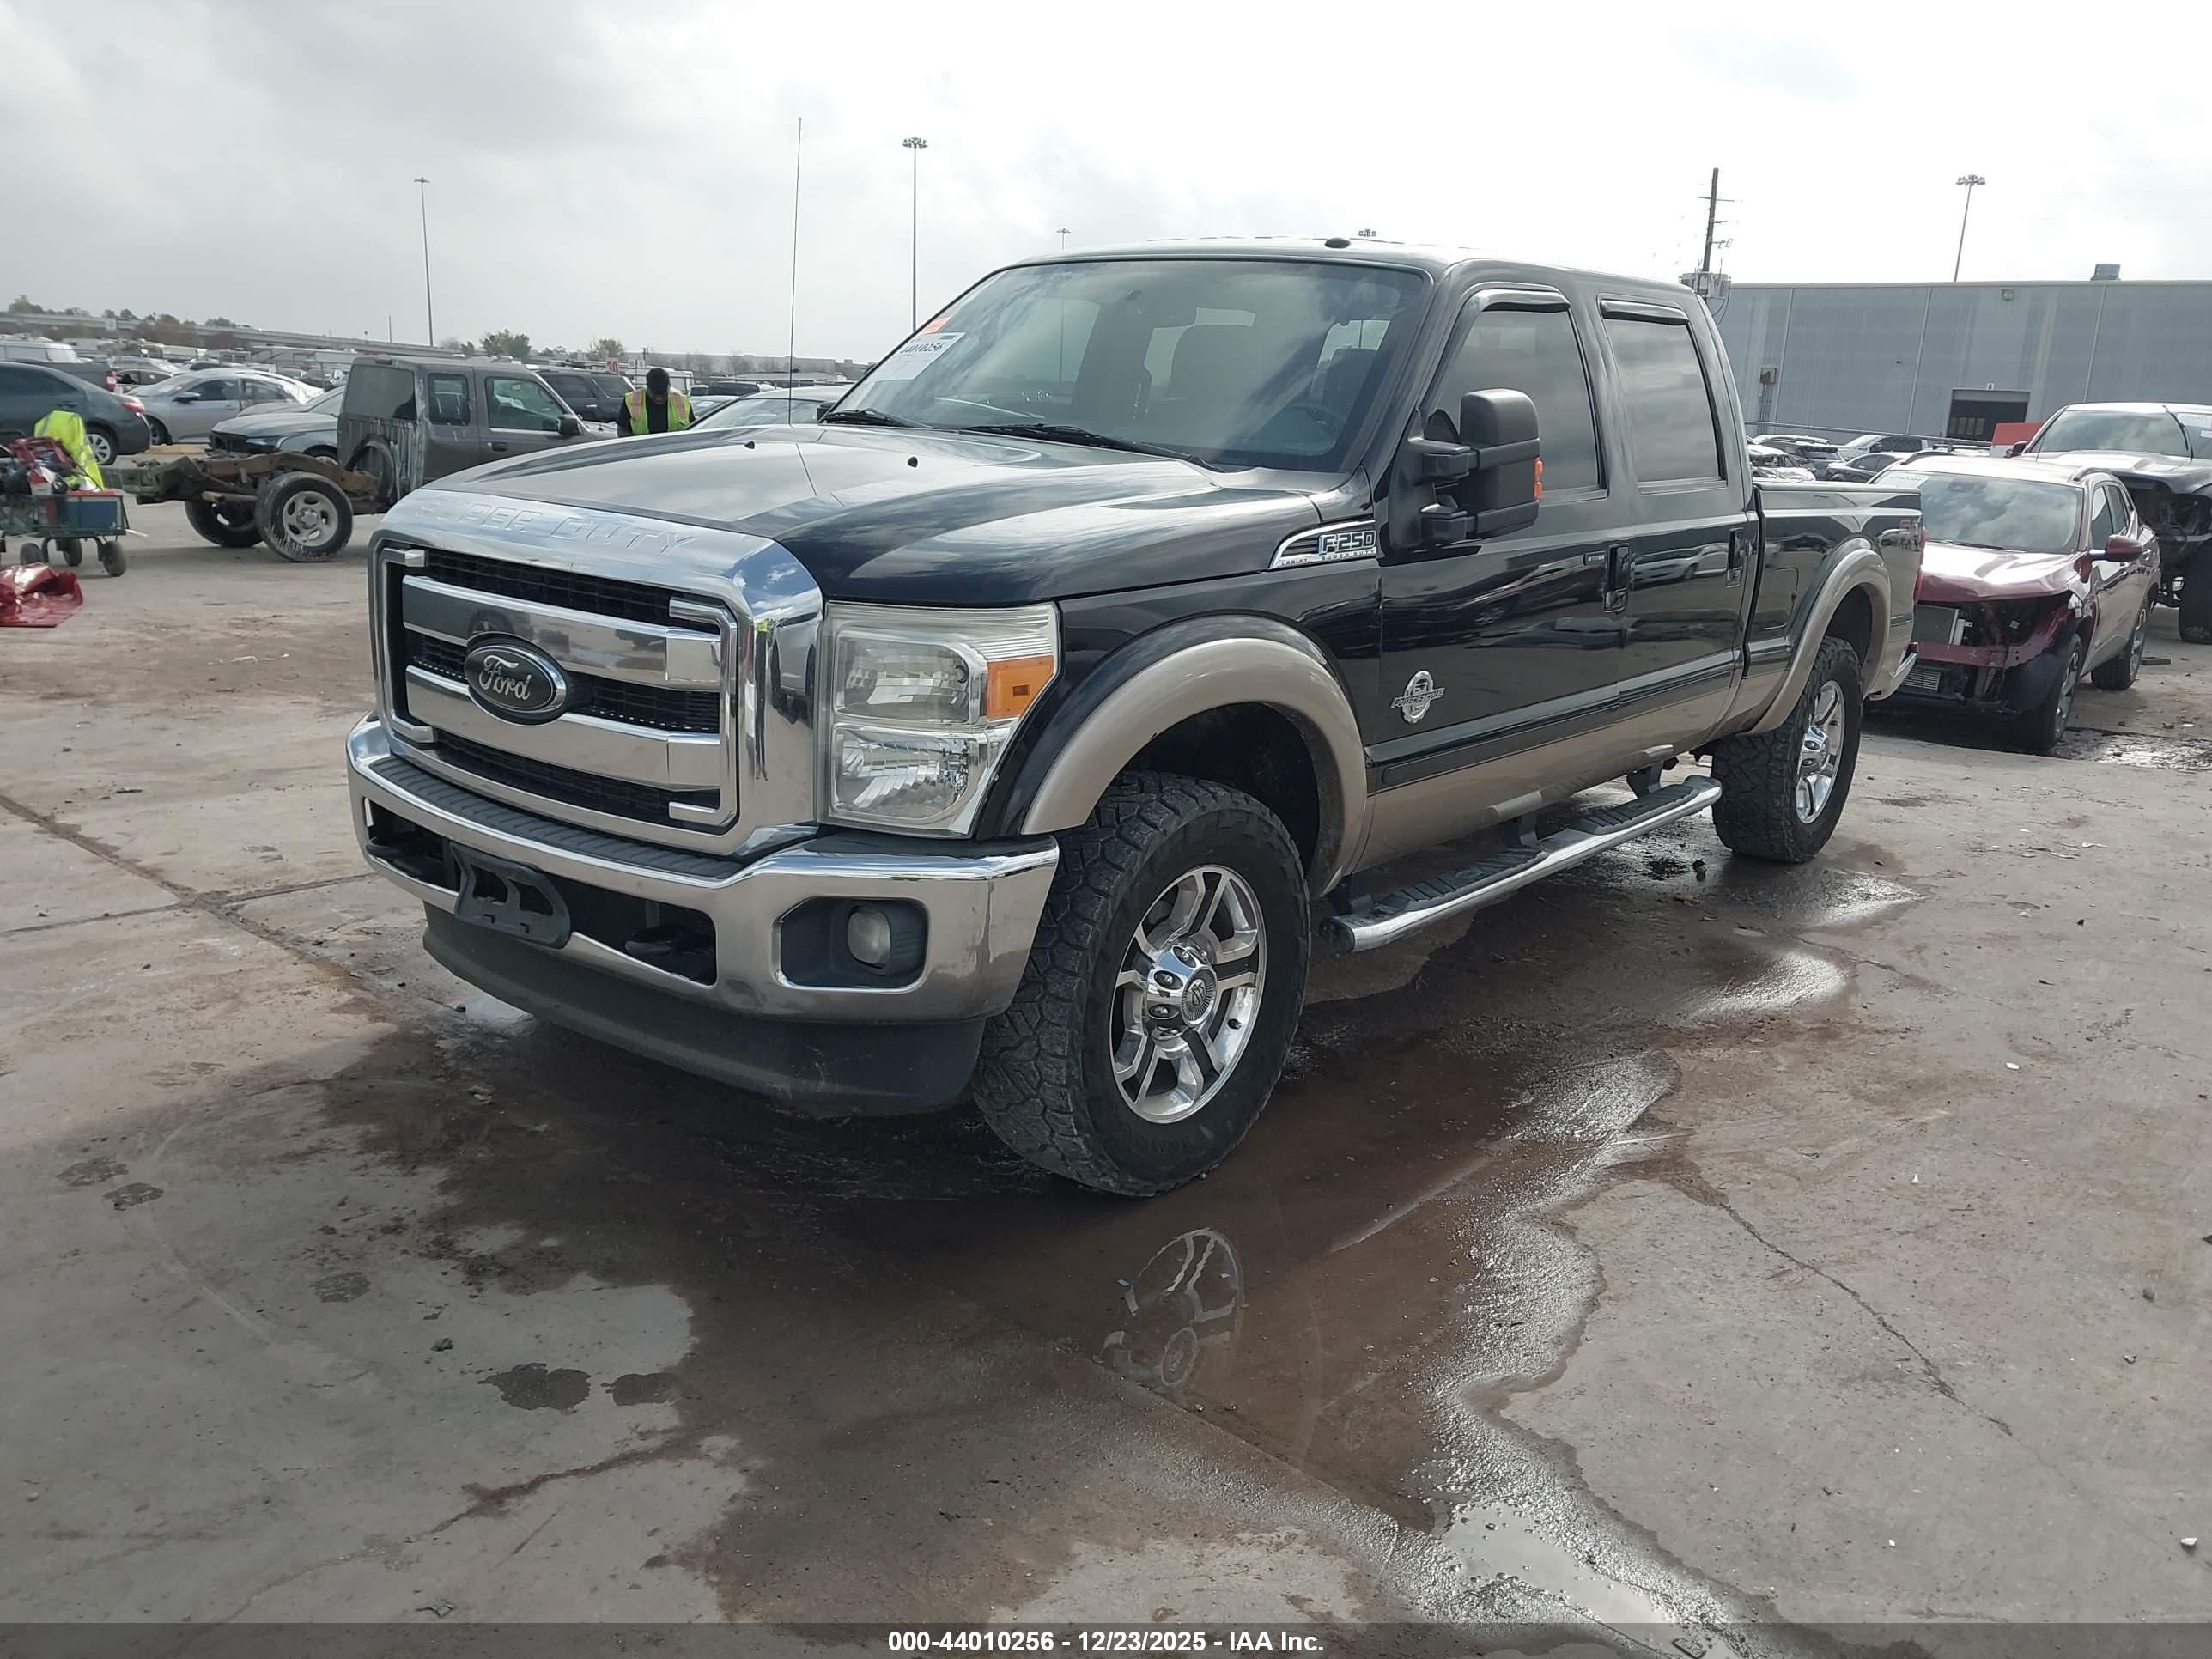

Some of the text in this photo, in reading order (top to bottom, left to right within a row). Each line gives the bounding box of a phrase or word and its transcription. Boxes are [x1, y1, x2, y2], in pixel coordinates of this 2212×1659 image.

[550, 517, 700, 554] DUTY
[1322, 531, 1375, 552] F-250
[478, 654, 532, 701] Ford
